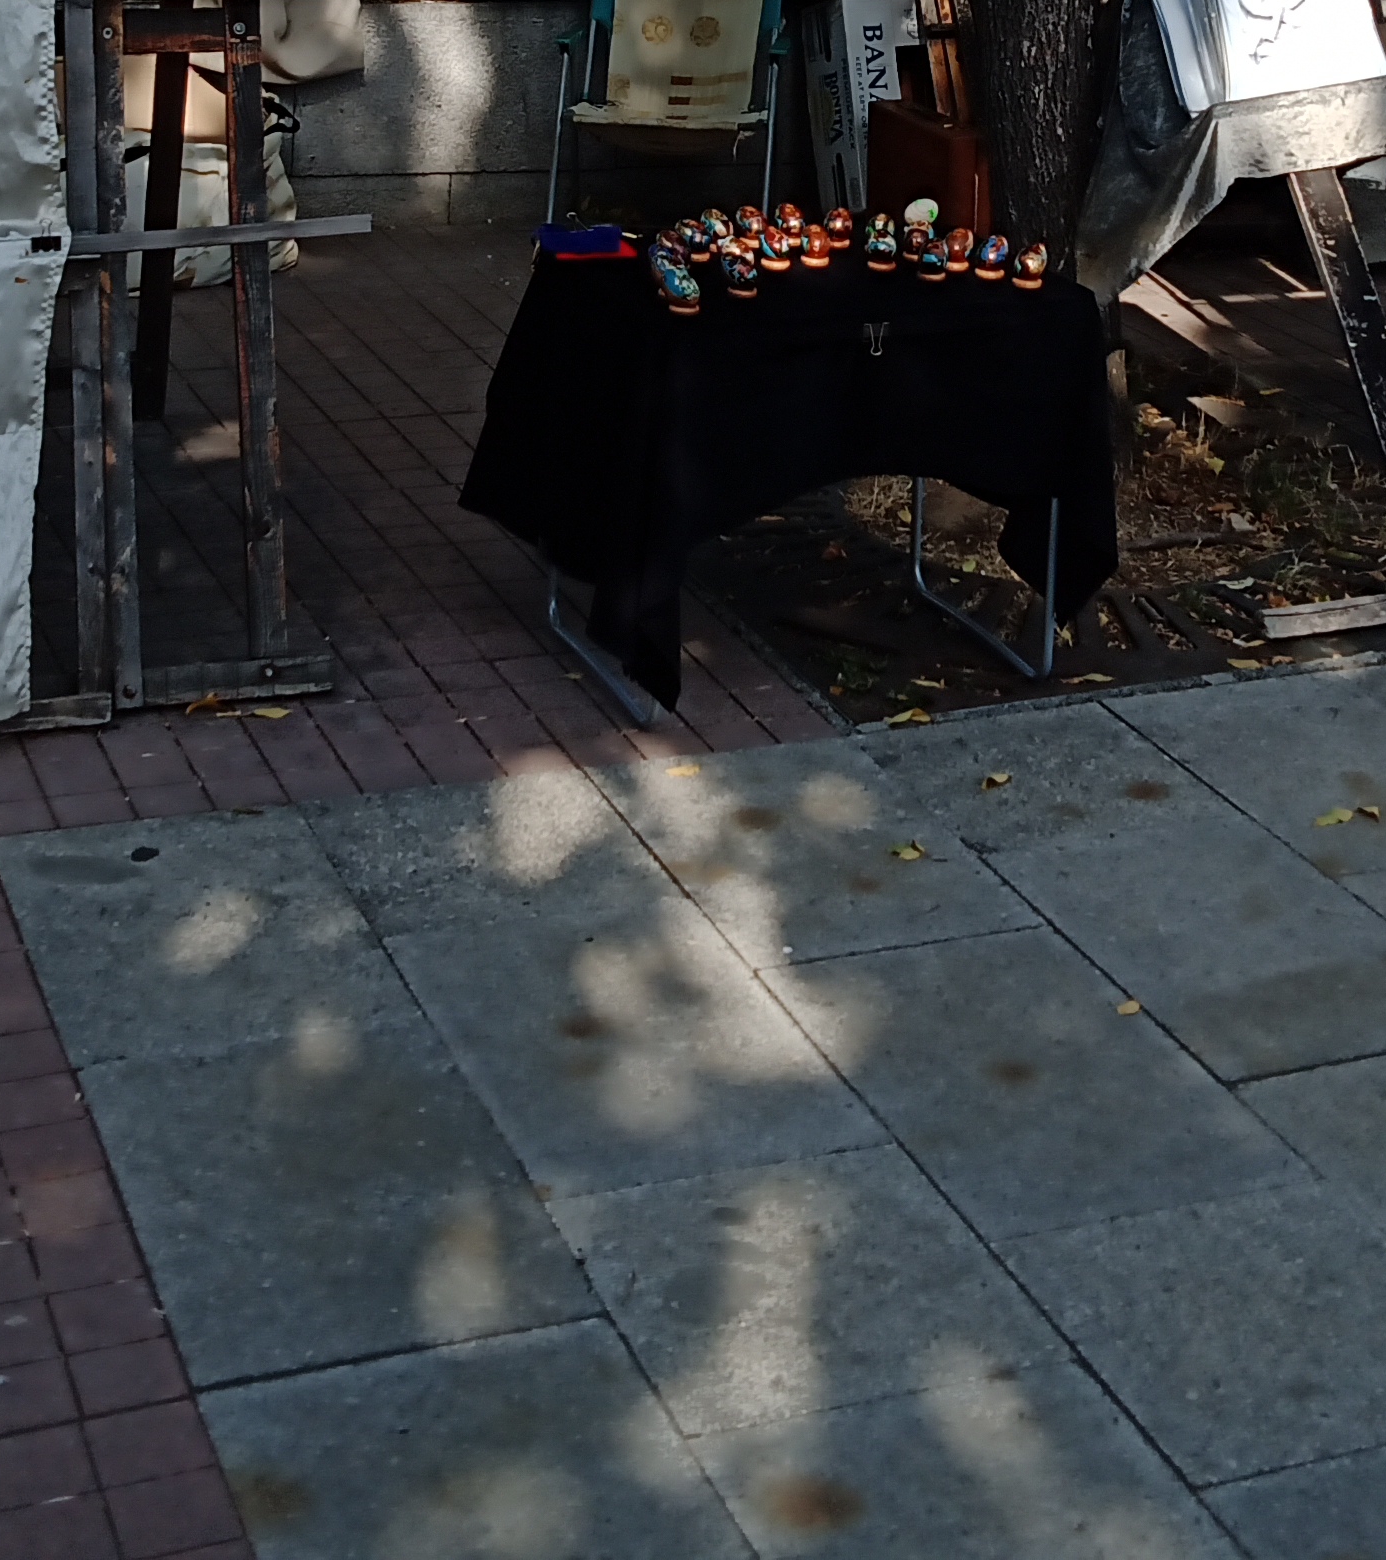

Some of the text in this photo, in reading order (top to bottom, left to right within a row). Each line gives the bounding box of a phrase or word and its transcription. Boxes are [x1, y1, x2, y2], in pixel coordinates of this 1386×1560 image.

[823, 71, 844, 145] BONITA
[841, 58, 855, 149] PREMIUM PACK
[857, 81, 864, 91] AT
